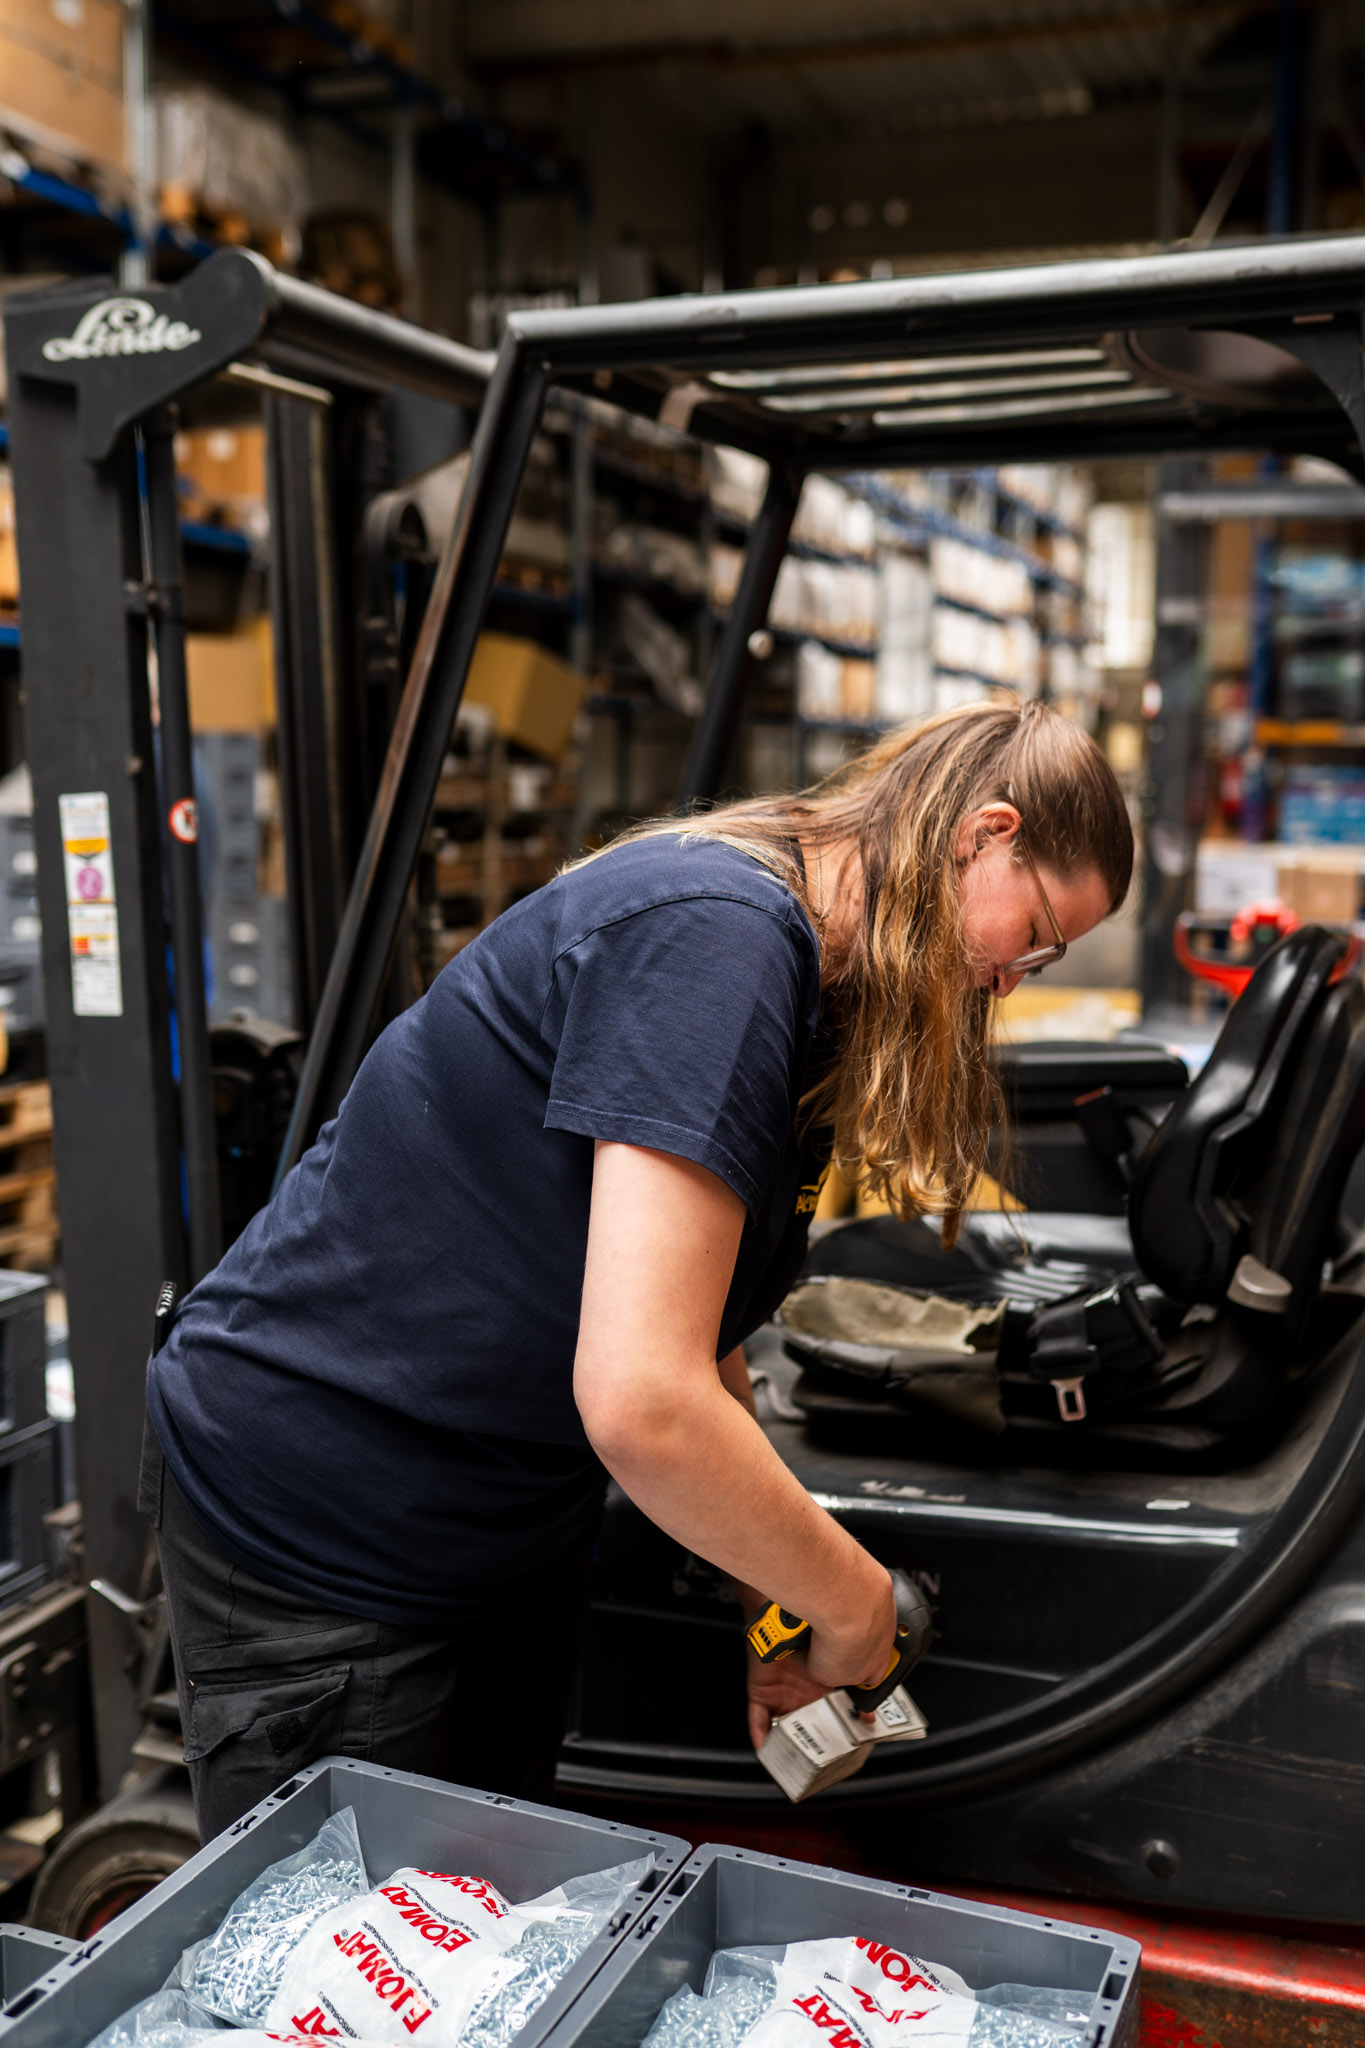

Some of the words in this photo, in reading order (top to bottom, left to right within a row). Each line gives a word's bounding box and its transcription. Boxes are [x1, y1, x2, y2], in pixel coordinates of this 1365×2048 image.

[42, 297, 201, 362] Linde
[361, 1920, 394, 1957] VERSCHRAUBUNG
[379, 1886, 472, 1953] EJOMAT
[333, 1931, 432, 2034] EJOMAT
[852, 1937, 938, 1992] JOM
[928, 1973, 941, 1985] DIE
[317, 1991, 358, 2038] VERSCHRAUBUNG
